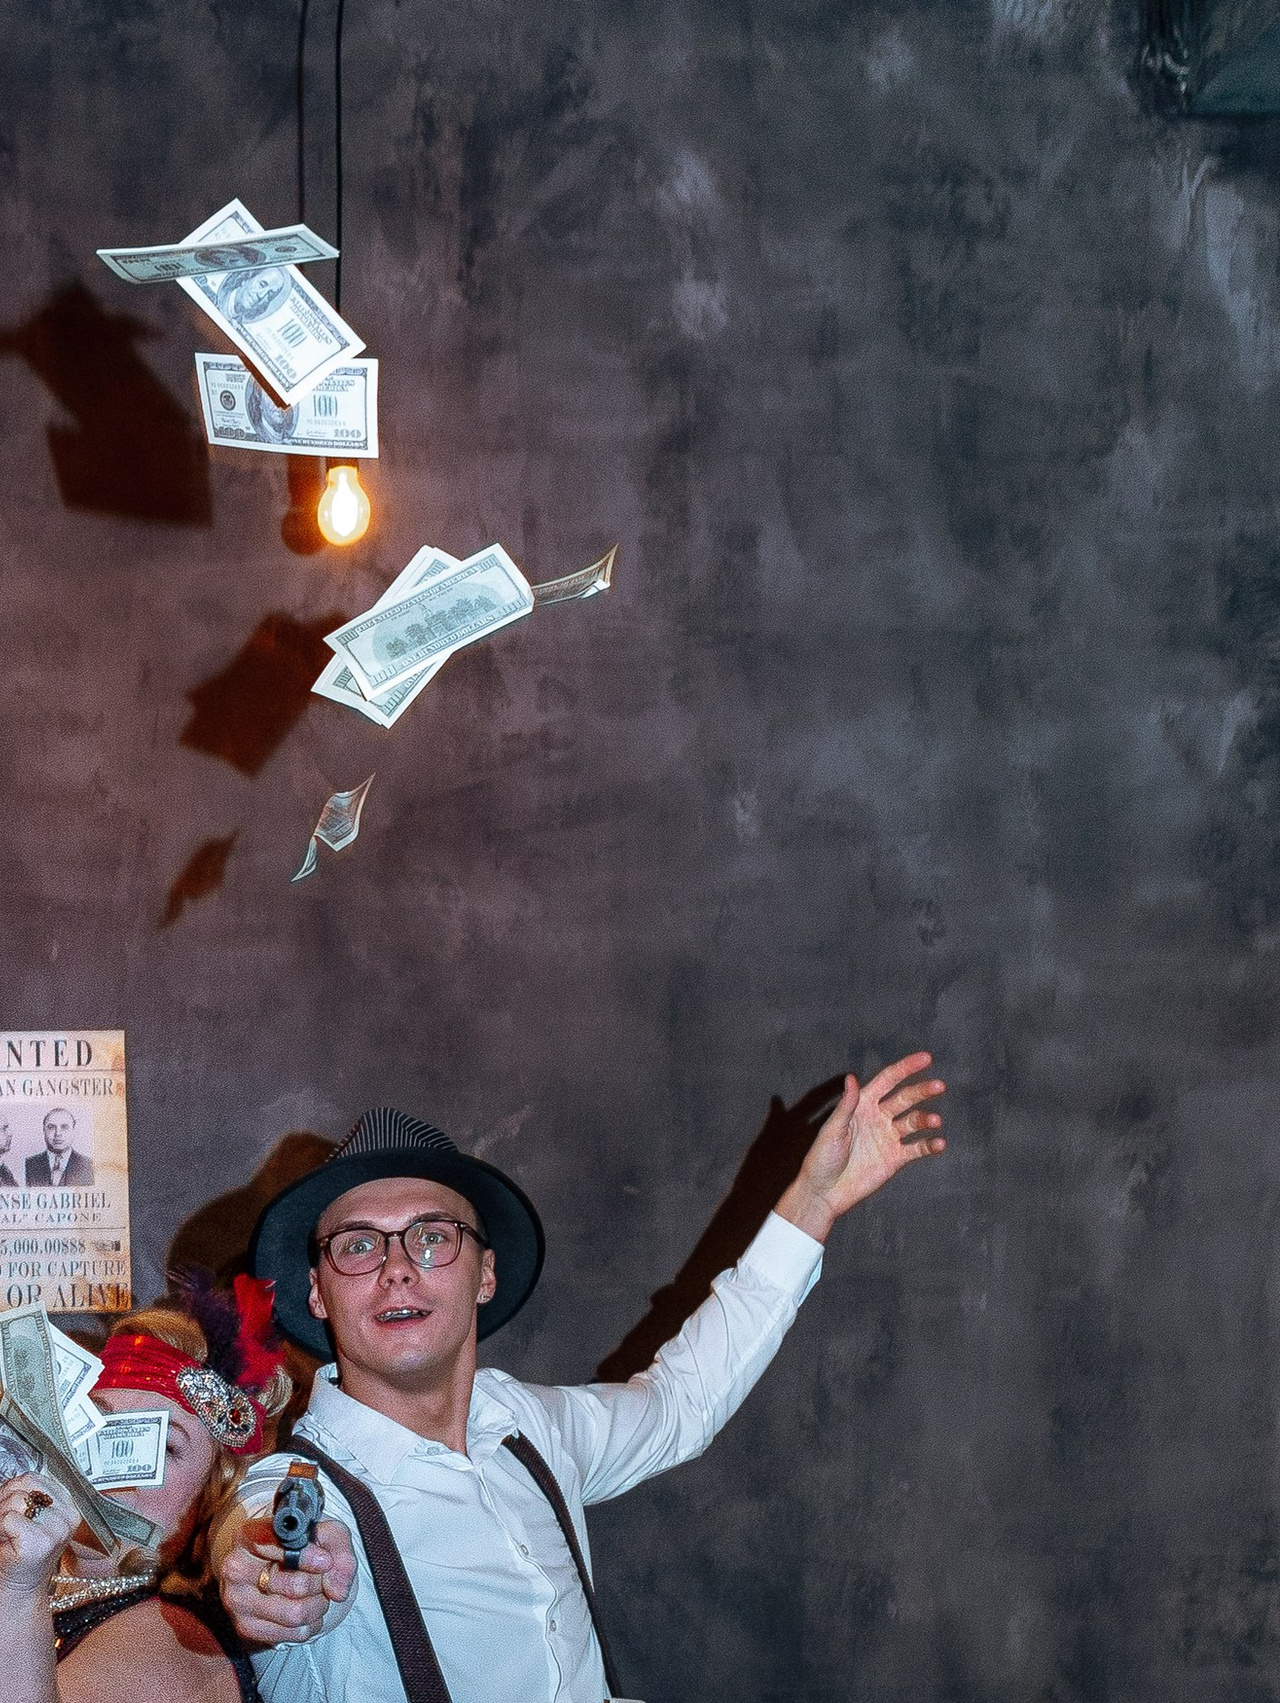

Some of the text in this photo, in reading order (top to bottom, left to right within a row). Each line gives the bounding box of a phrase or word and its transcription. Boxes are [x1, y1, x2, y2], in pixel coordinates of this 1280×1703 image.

[22, 1078, 114, 1096] GANGSTER
[36, 1192, 111, 1210] GABRIEL
[34, 1212, 102, 1223] CAPONE
[8, 1261, 42, 1278] FOR
[47, 1260, 127, 1278] CAPTURE
[6, 1284, 43, 1305] OR
[53, 1282, 132, 1308] ALIVE
